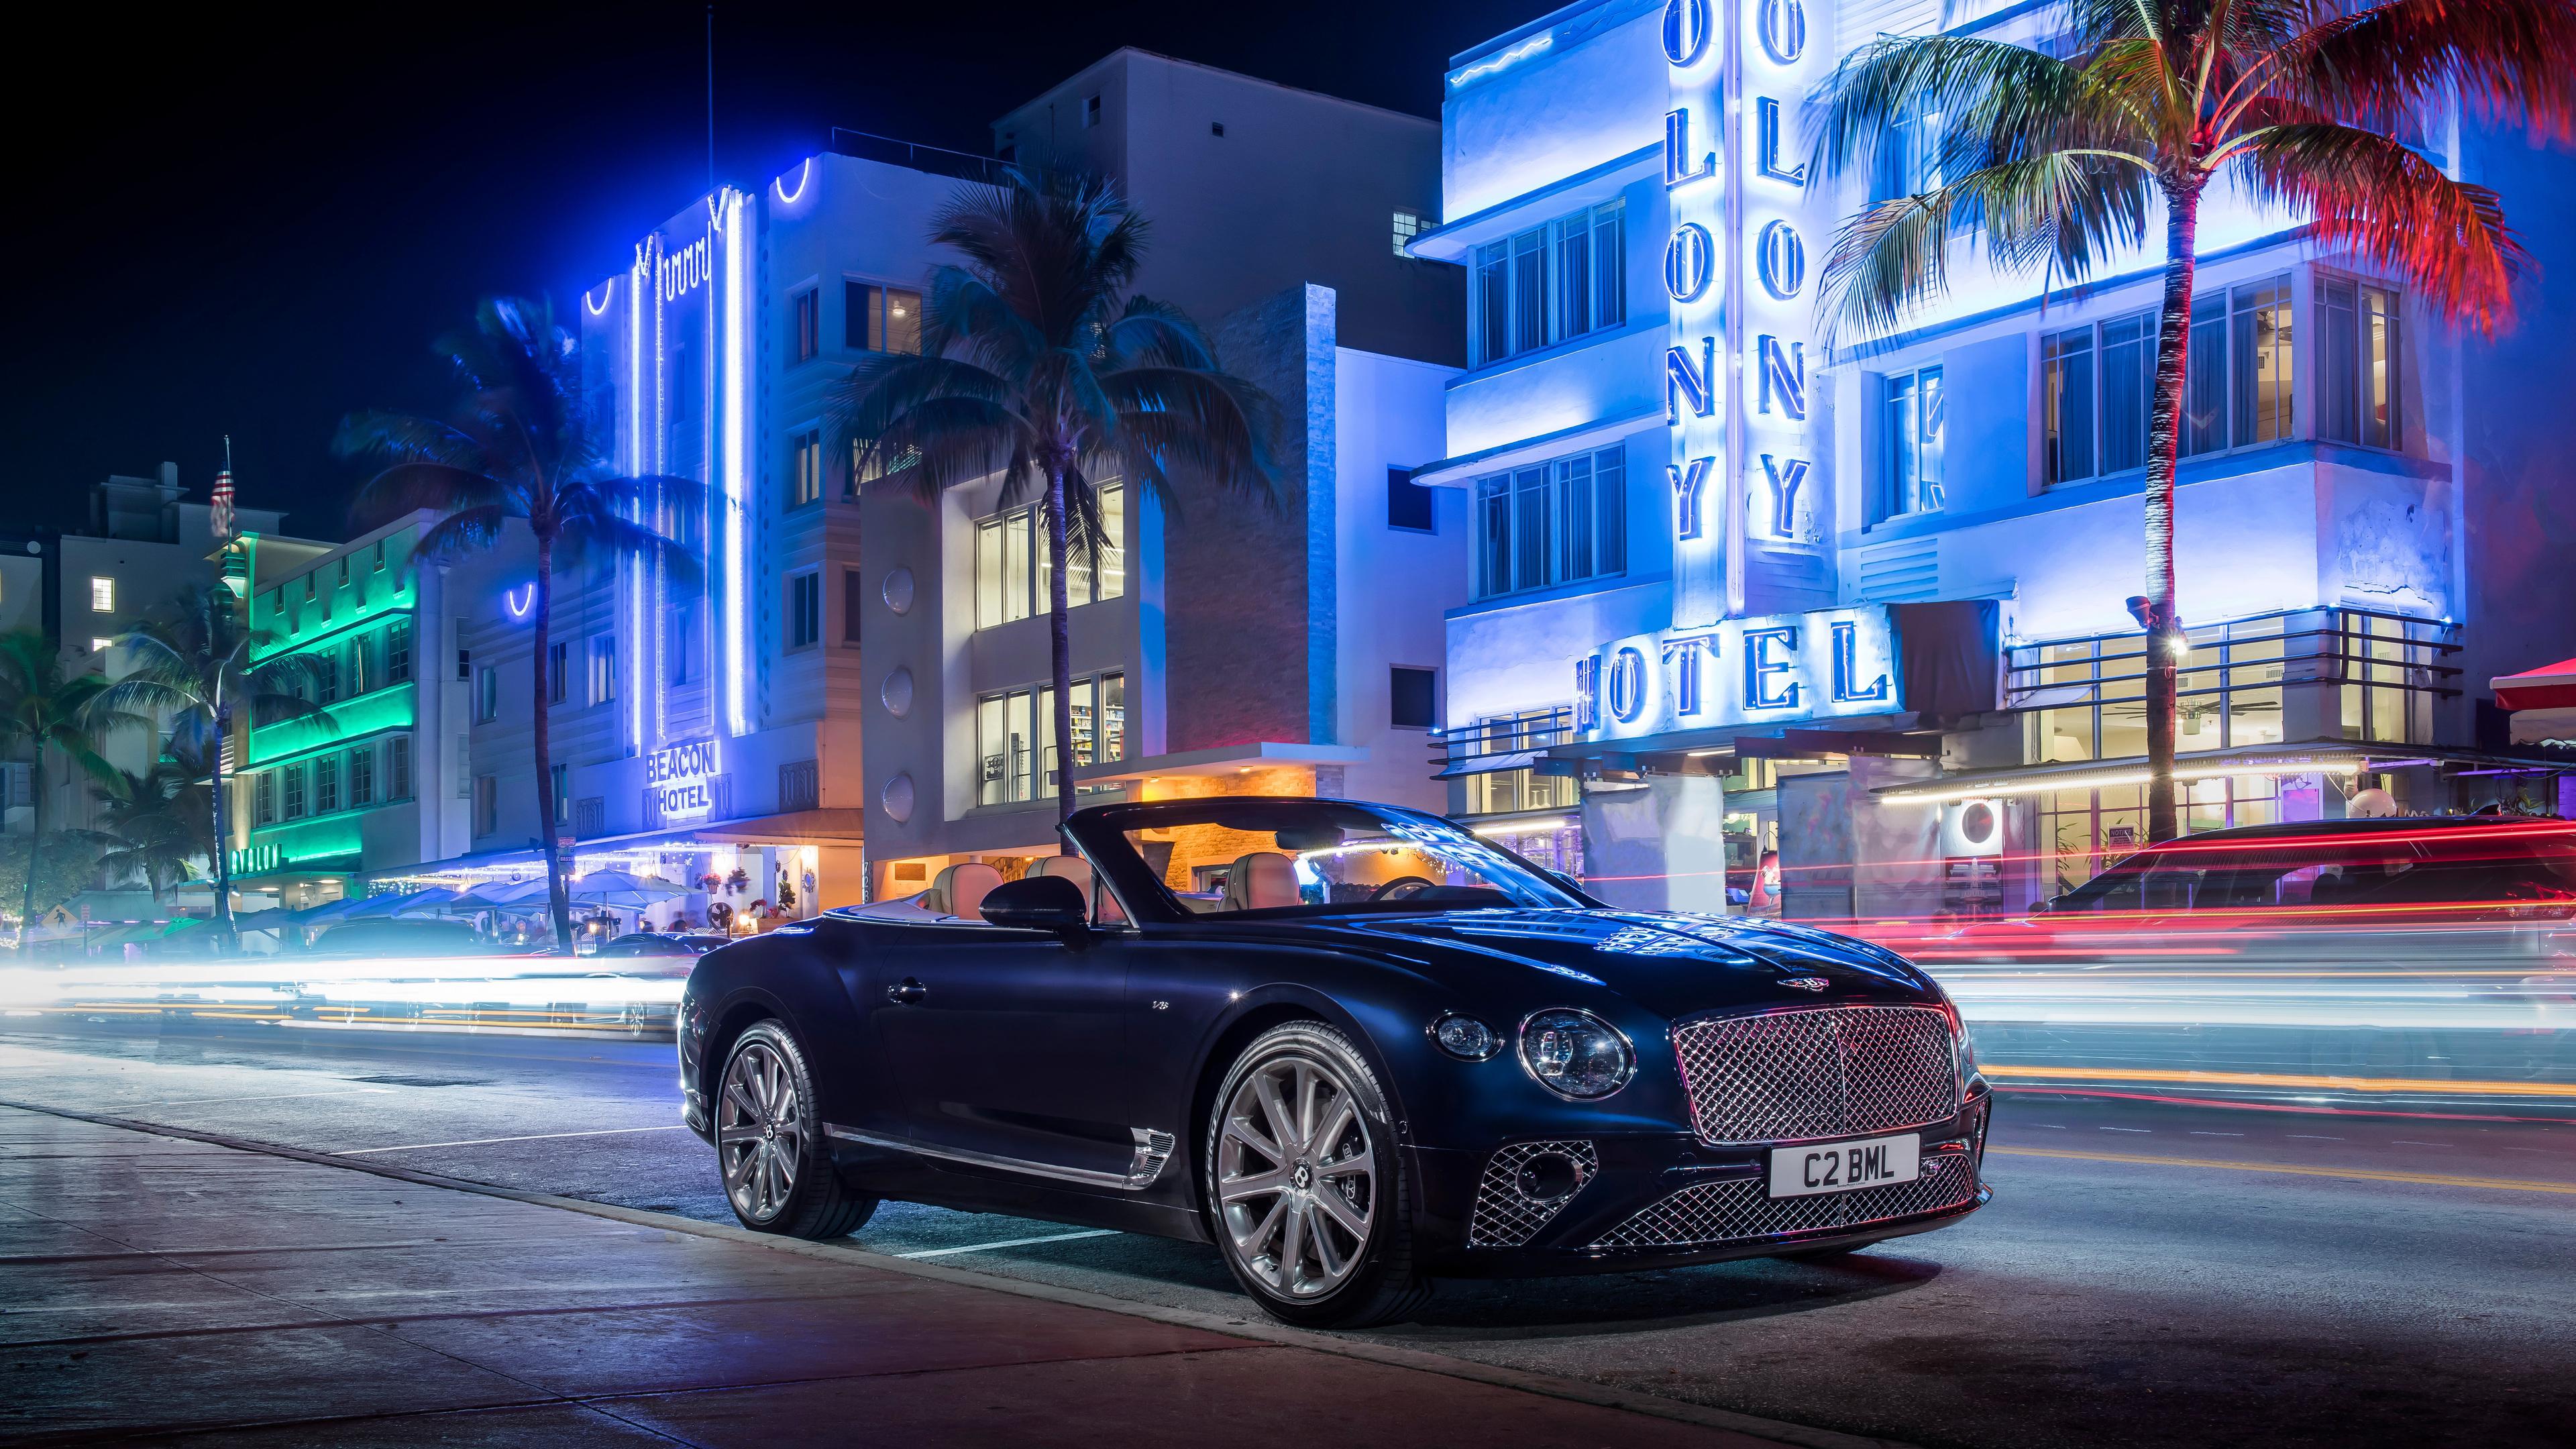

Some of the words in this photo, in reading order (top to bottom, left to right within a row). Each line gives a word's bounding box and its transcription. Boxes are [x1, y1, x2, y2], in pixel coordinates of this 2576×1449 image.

[1662, 0, 1716, 541] OLONY
[1756, 0, 1811, 539] OLONY
[1572, 621, 1887, 735] HOTEL
[646, 743, 715, 784] BEACON
[658, 786, 708, 812] HOTEL
[232, 843, 278, 875] AVALON
[1804, 1151, 1839, 1188] C2
[1847, 1144, 1894, 1183] BML
